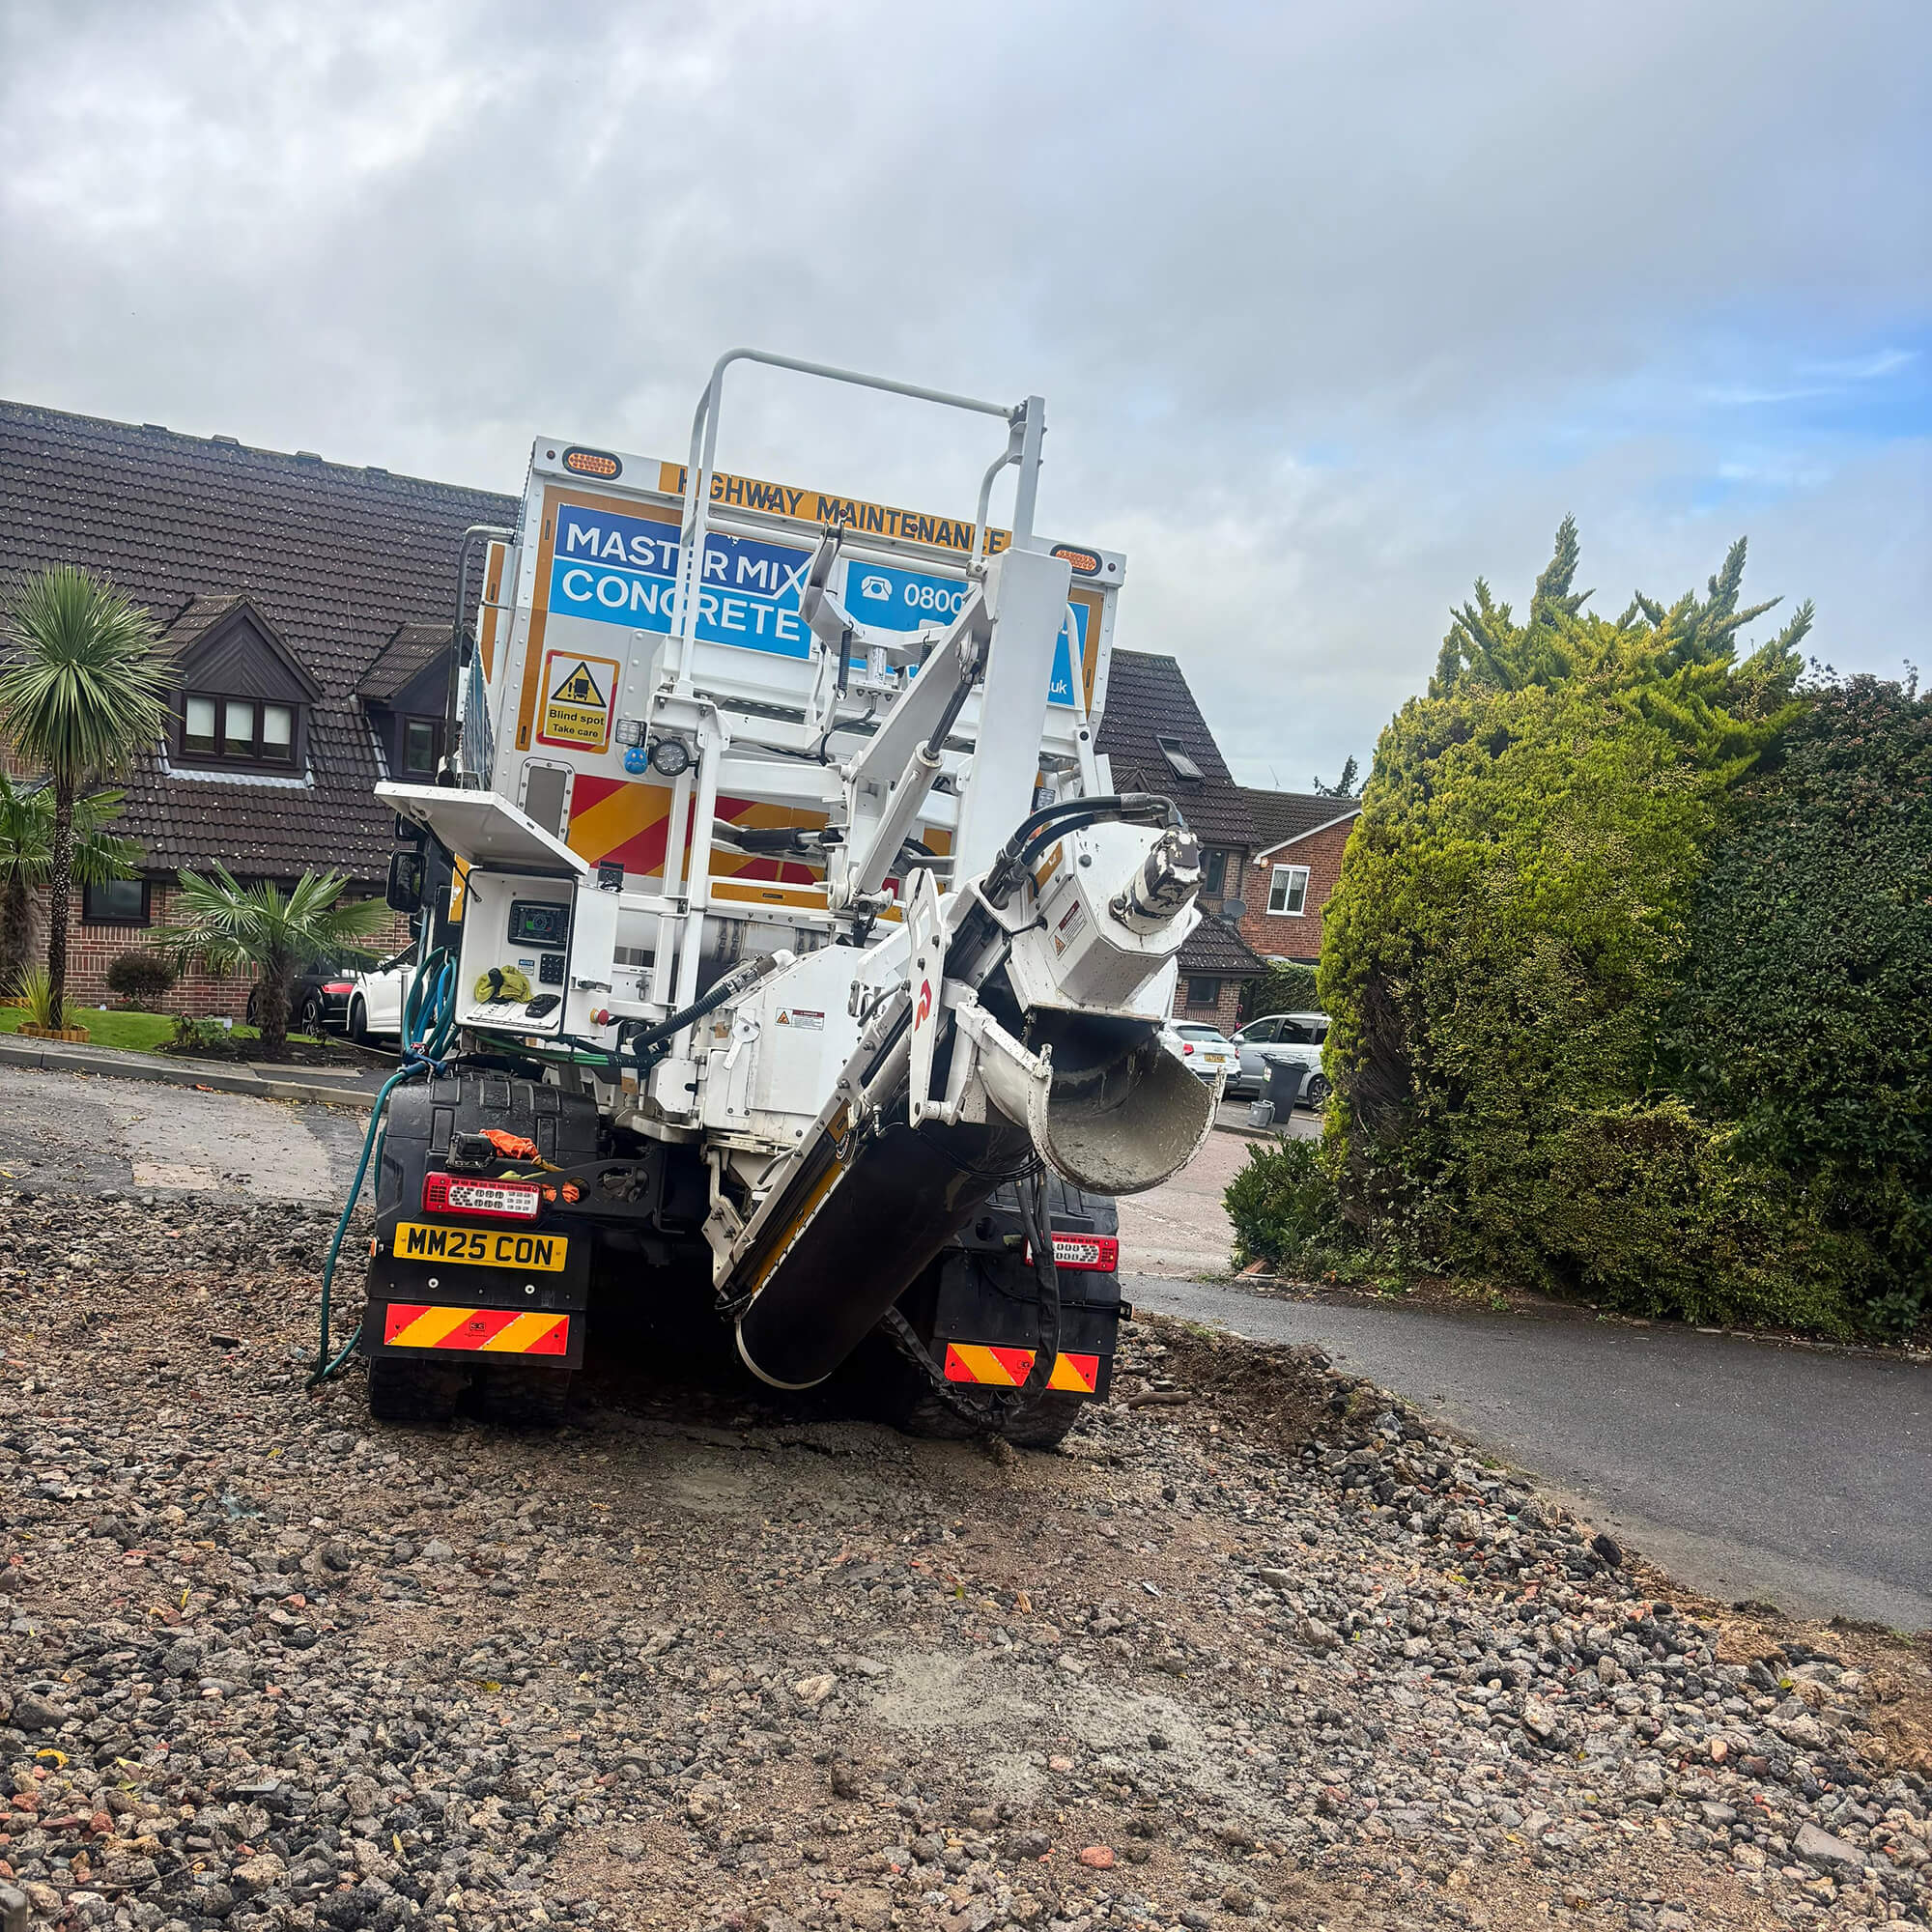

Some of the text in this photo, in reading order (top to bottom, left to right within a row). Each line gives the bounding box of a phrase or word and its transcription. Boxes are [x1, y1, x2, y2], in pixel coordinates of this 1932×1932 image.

[736, 554, 814, 599] MIX
[561, 569, 802, 641] CONCRETE
[904, 582, 963, 615] 0800
[549, 709, 605, 725] Blind spot
[553, 723, 599, 738] Take care
[407, 1227, 554, 1265] MM25 CON
